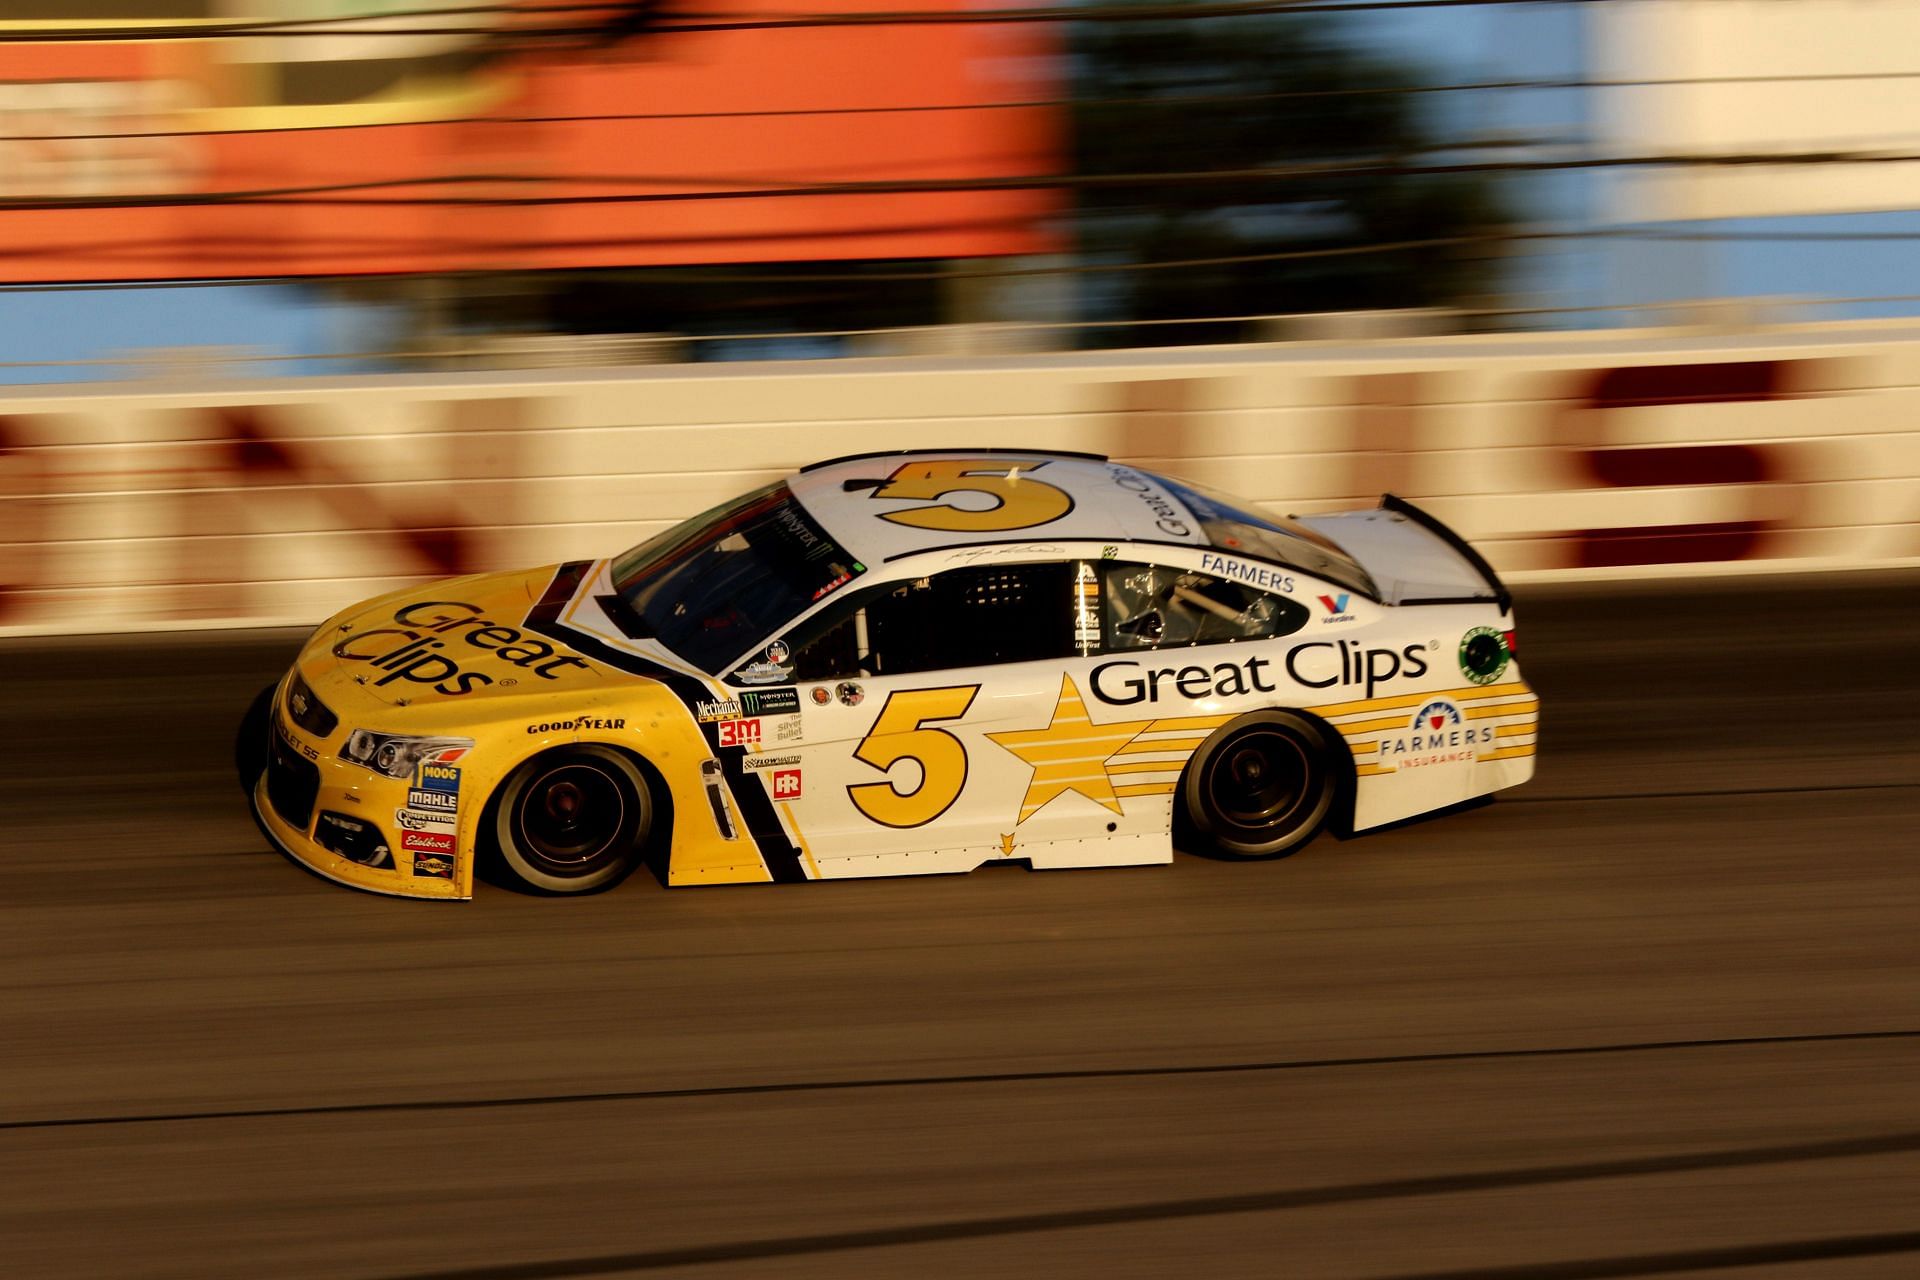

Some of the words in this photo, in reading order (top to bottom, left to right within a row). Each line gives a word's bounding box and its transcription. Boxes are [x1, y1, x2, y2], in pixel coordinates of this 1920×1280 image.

[869, 459, 1076, 533] 5
[1201, 553, 1295, 594] FARMERS
[393, 601, 590, 681] Great
[331, 629, 494, 696] Clips
[1090, 659, 1274, 706] Great
[1285, 639, 1428, 699] Clips
[696, 697, 739, 717] Mechanix
[720, 719, 761, 746] 3M
[777, 729, 802, 741] Bullet
[778, 720, 802, 732] Silver
[1380, 727, 1493, 757] FARMERS
[846, 683, 982, 829] 5
[1399, 751, 1474, 770] INSURANCE
[424, 767, 457, 780] MOOG
[410, 791, 457, 807] MAHLE
[405, 835, 452, 849] Edelbrock
[415, 860, 454, 871] SUNOCO
